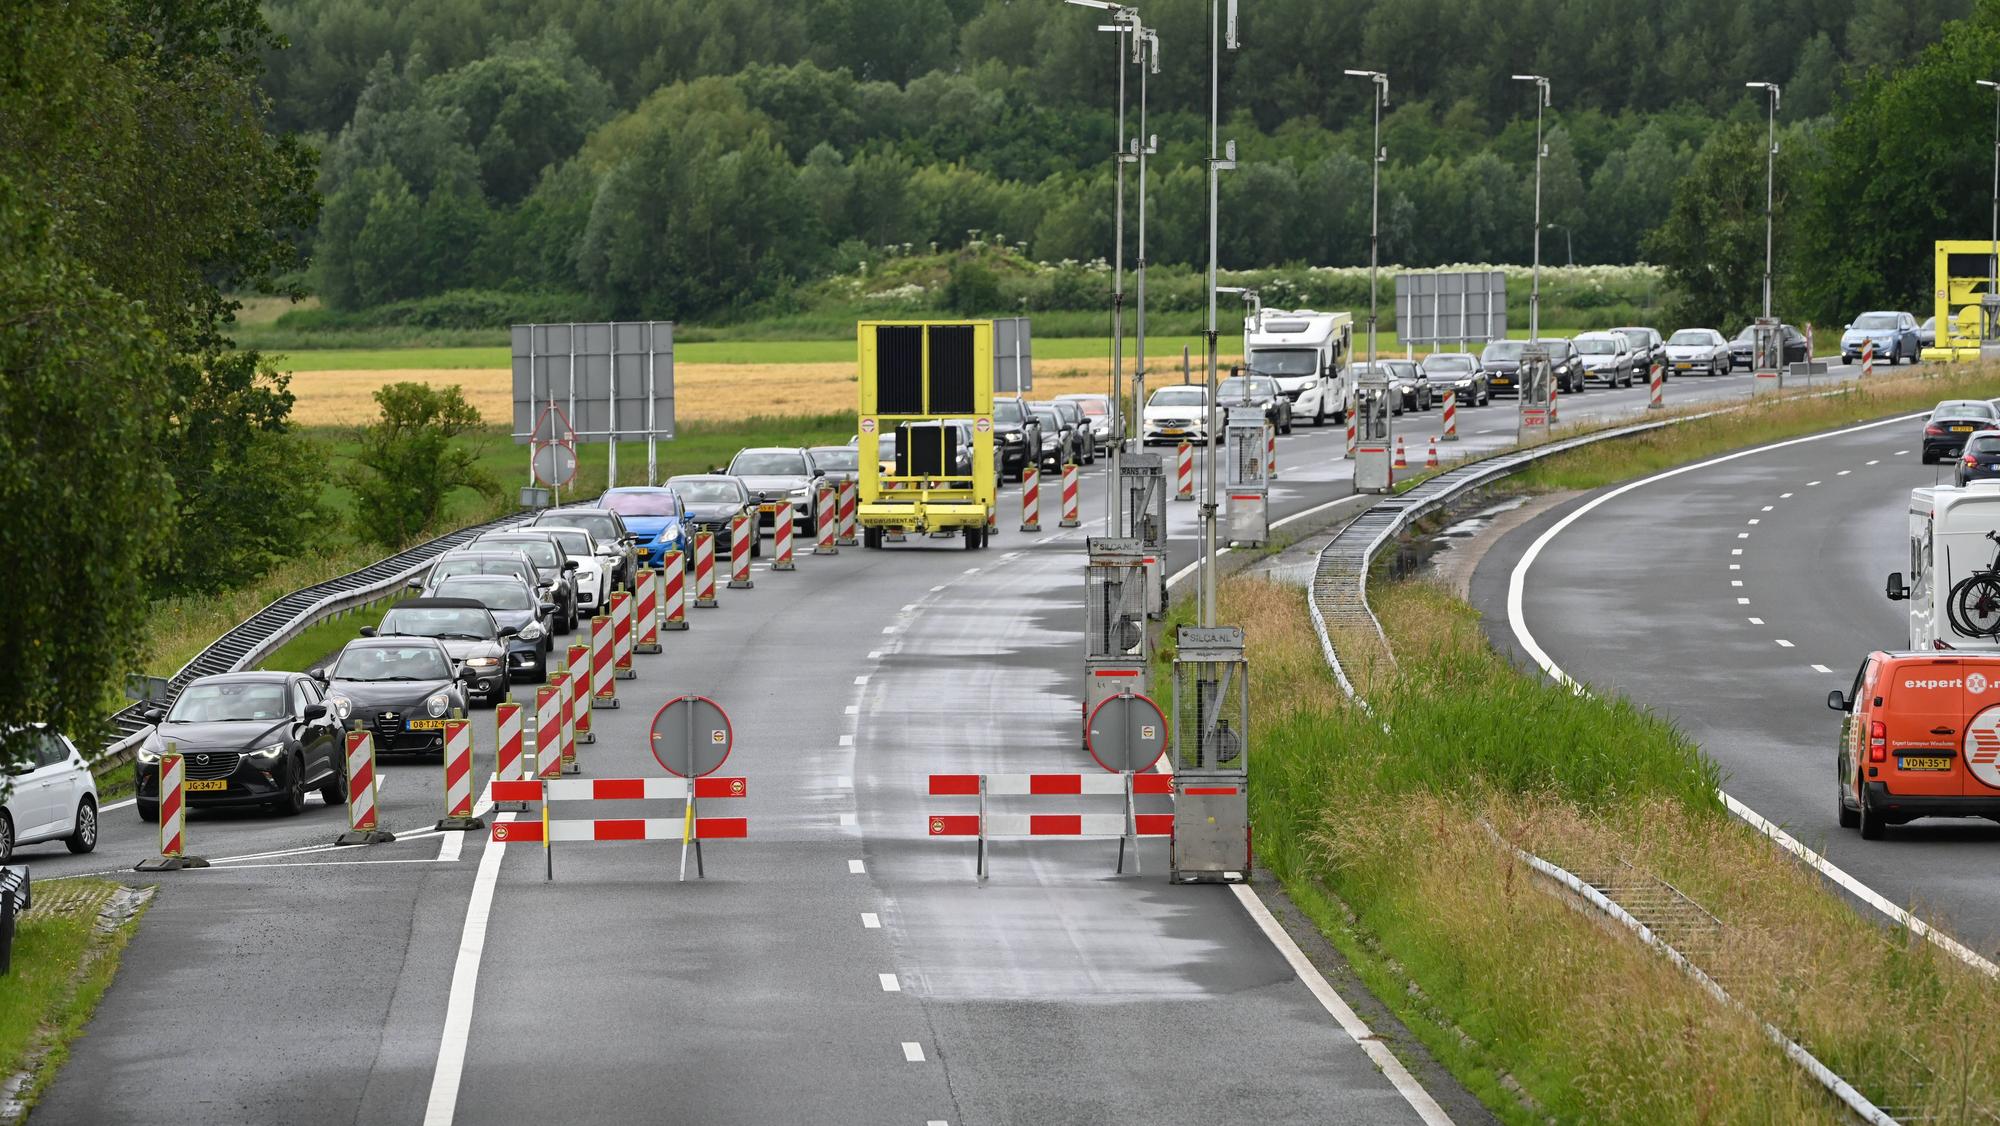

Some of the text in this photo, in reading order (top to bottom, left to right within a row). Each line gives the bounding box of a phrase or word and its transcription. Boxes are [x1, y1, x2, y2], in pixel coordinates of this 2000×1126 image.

[1905, 679, 1962, 689] expert
[1905, 759, 1948, 768] VDN-35-T
[187, 781, 222, 790] JG-347-J
